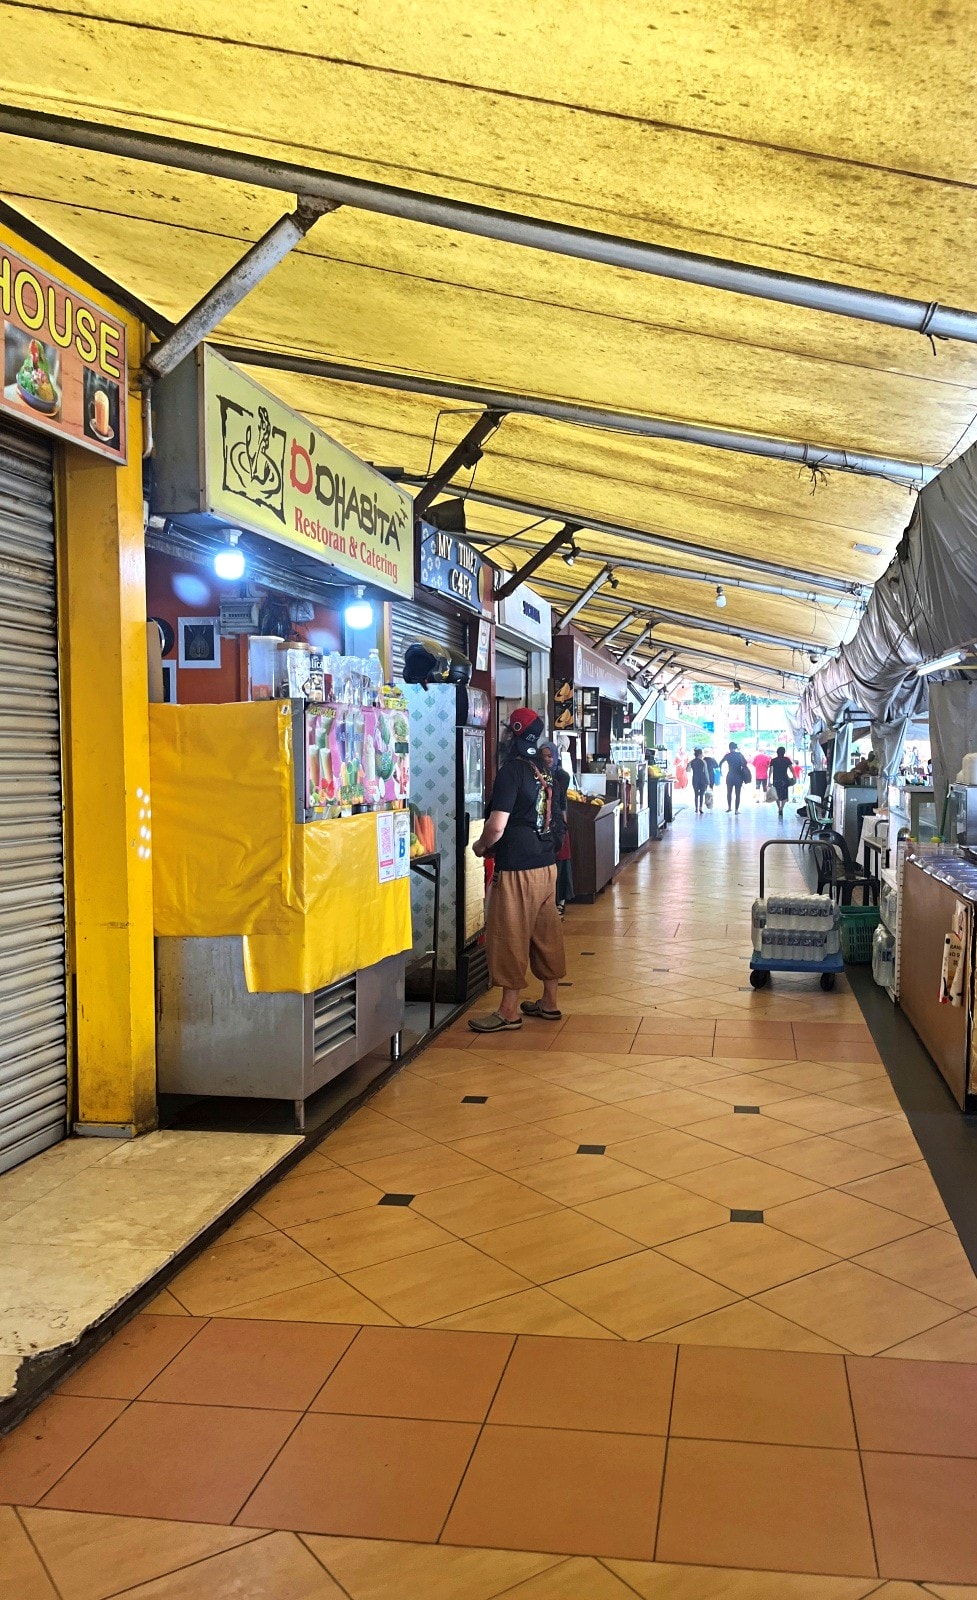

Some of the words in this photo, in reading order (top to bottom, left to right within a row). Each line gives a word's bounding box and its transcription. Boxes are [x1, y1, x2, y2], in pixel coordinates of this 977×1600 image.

[294, 506, 346, 554] Restoran
[349, 535, 358, 560] &
[360, 541, 398, 583] Catering
[437, 532, 453, 561] MY
[451, 568, 473, 601] CAFE
[398, 837, 406, 858] B
